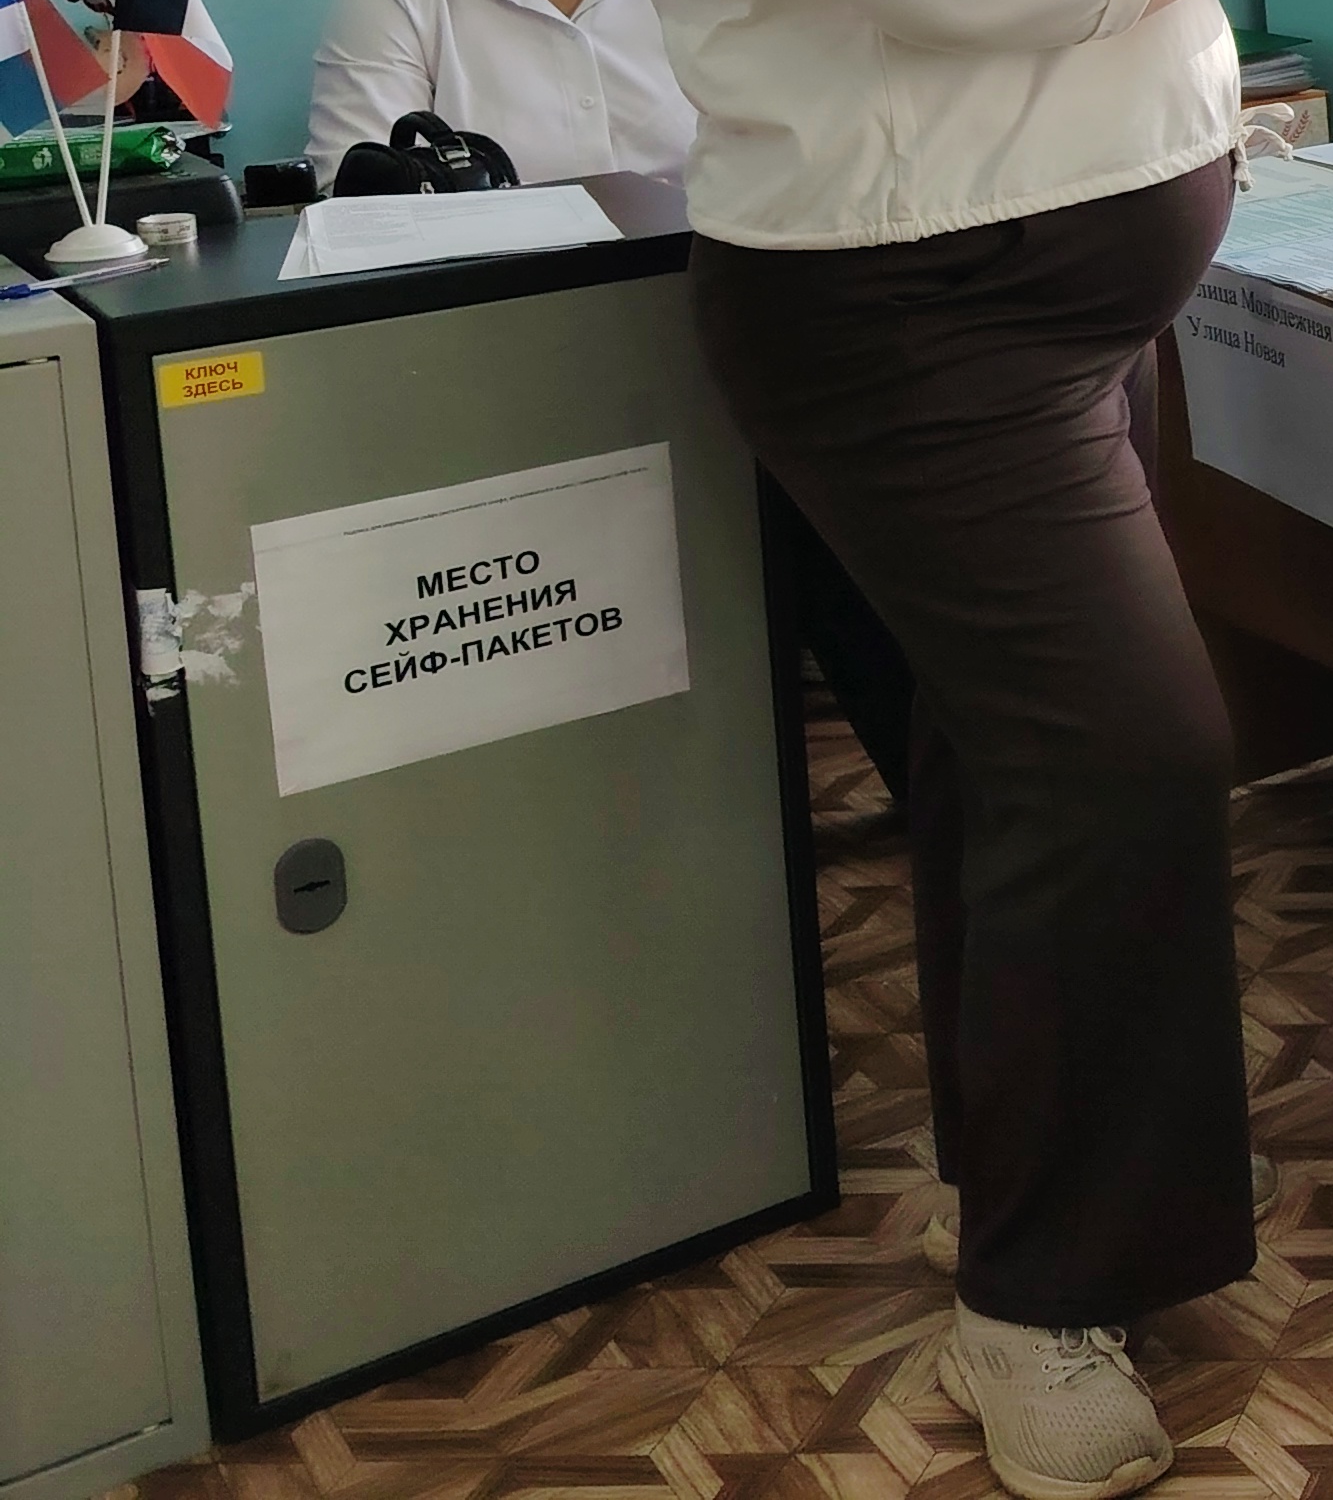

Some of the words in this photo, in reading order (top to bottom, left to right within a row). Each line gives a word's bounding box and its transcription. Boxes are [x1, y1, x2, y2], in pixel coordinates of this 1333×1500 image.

[1195, 283, 1238, 307] лица
[1241, 286, 1333, 342] Молодежная
[1186, 315, 1241, 349] Улица
[1244, 330, 1286, 368] Новая
[182, 377, 244, 400] ЗДЕСЬ
[184, 361, 240, 381] КЛЮЧ
[416, 549, 541, 600] МЕСТО
[383, 578, 578, 647] ХРАНЕНИЯ
[343, 606, 624, 696] СЕЙФ-ПАКЕТОВ
